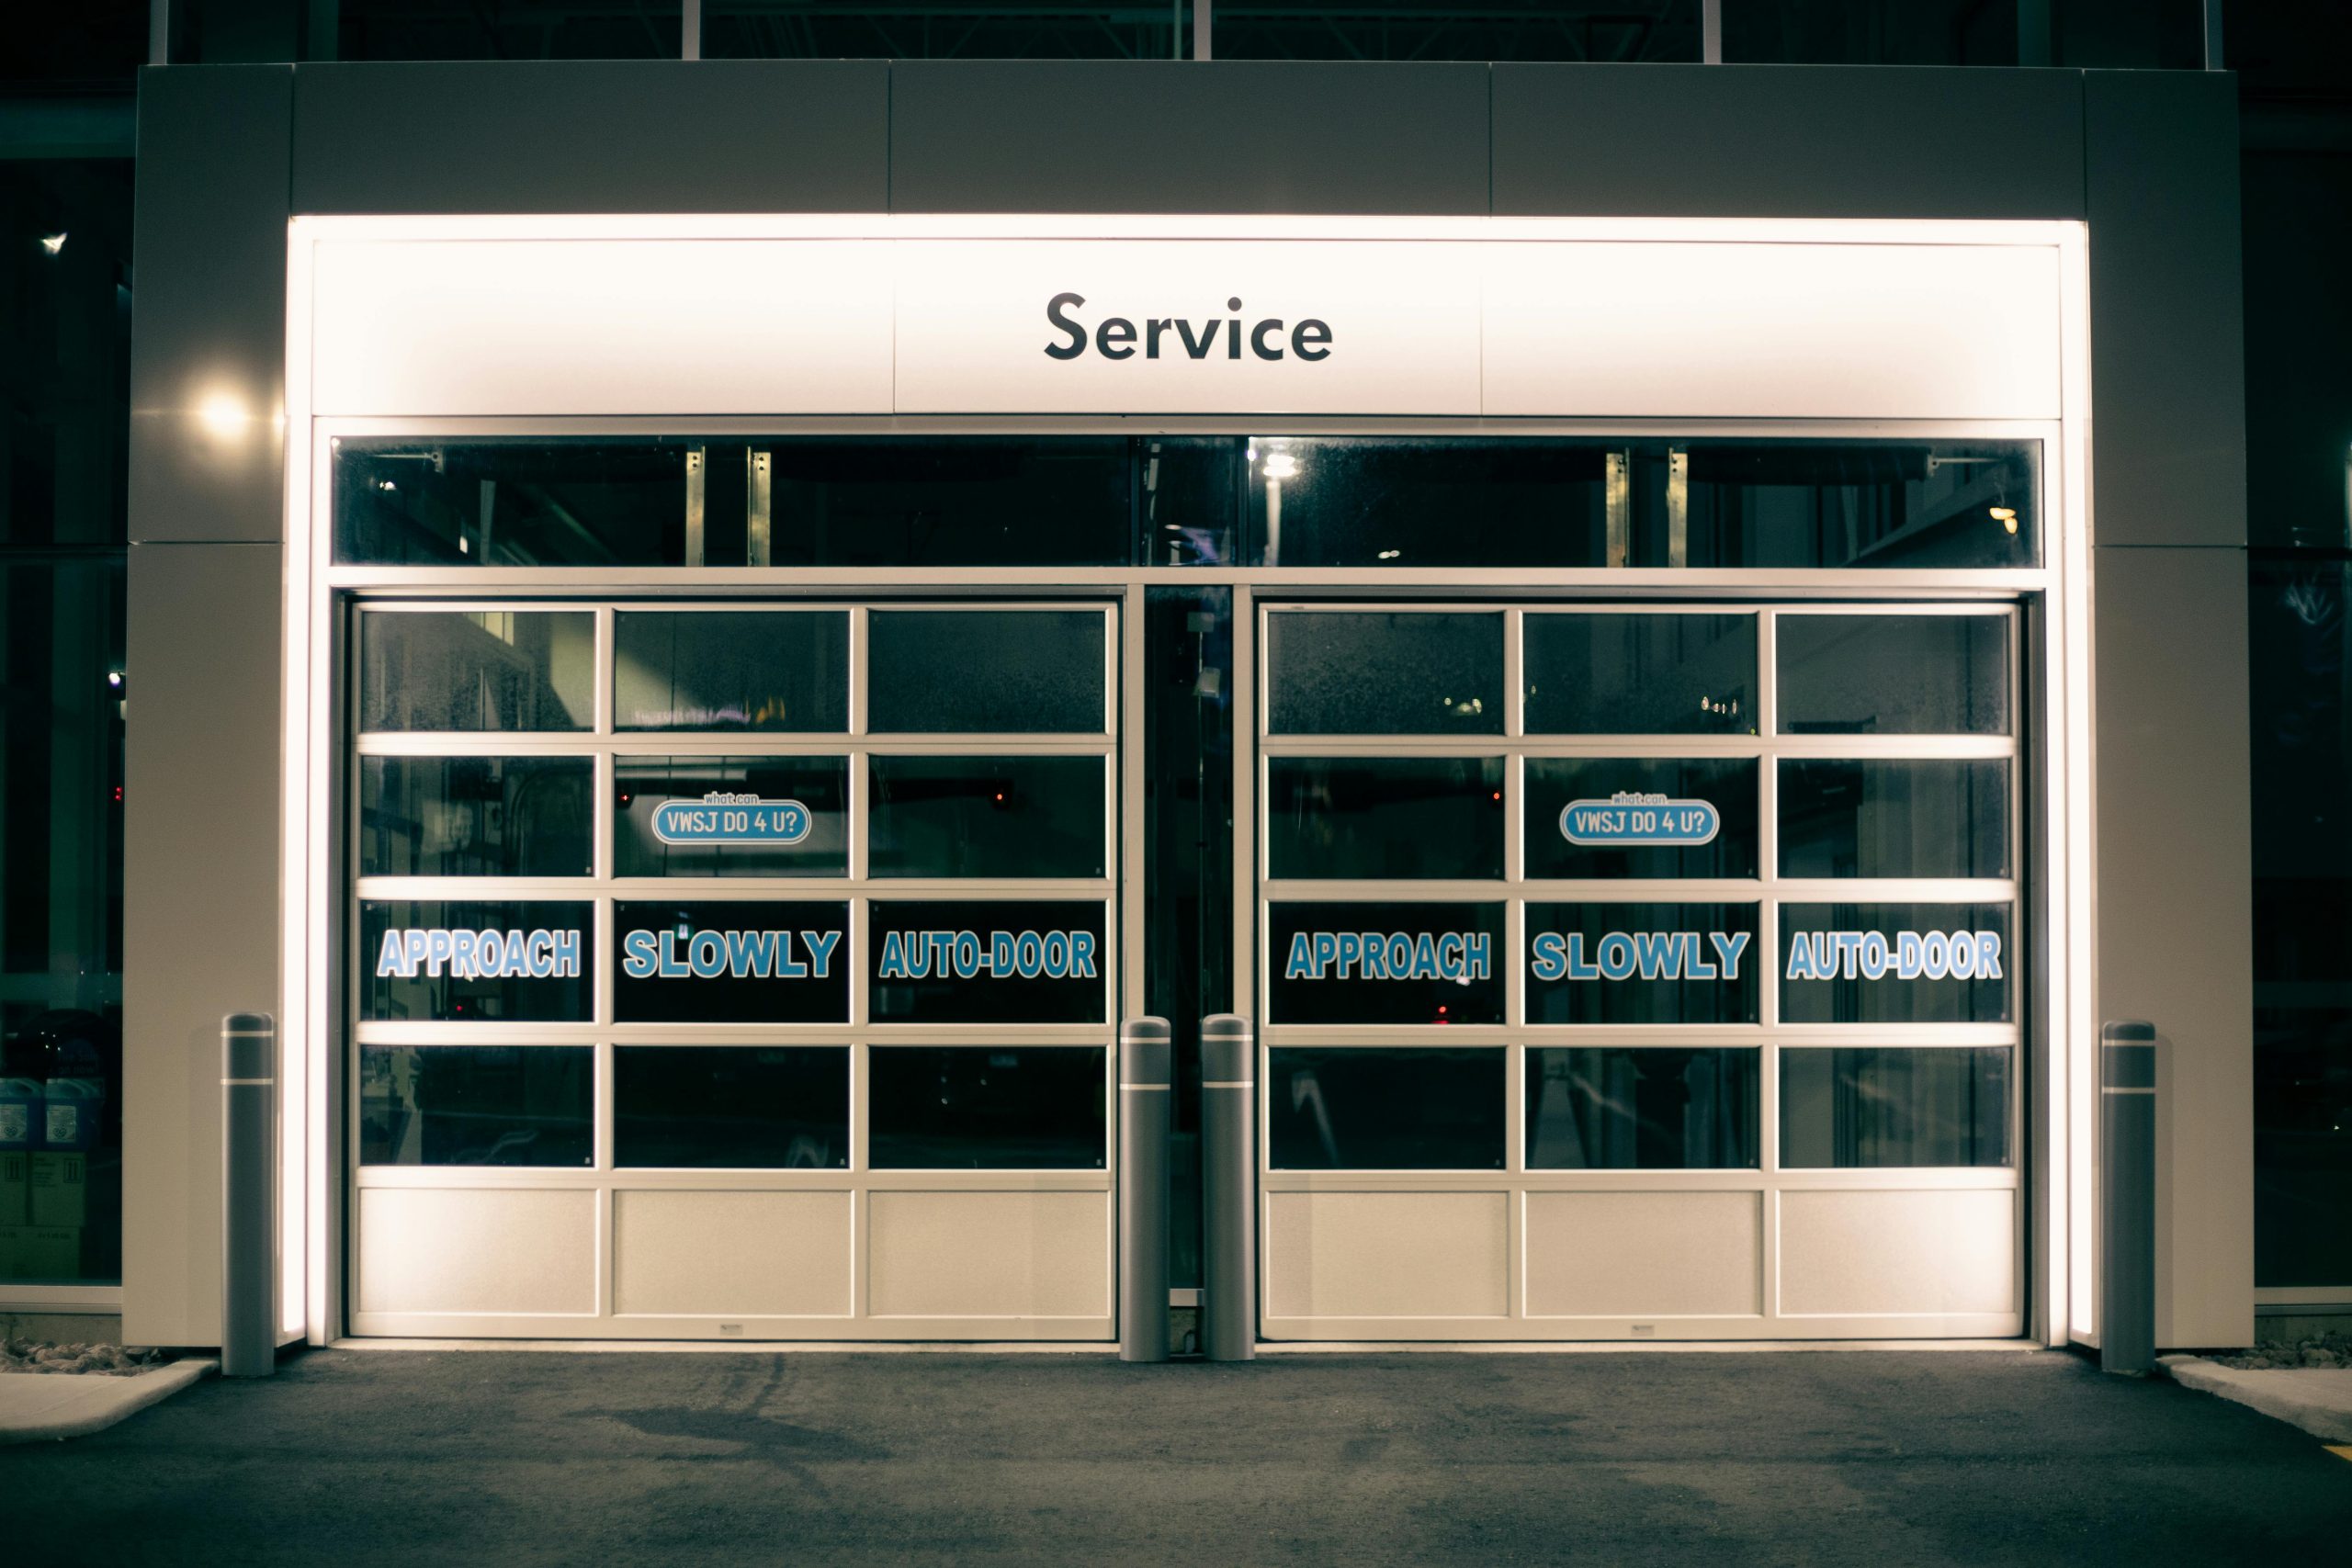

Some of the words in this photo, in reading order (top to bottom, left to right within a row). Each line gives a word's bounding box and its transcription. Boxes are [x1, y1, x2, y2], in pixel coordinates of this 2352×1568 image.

[1044, 292, 1332, 361] Service
[705, 791, 734, 805] what
[736, 794, 759, 805] can
[1612, 791, 1641, 805] what
[1644, 794, 1667, 805] can
[667, 811, 718, 833] VWSJ
[724, 811, 748, 833] DO
[753, 811, 767, 832] 4
[773, 811, 797, 833] U?
[1575, 811, 1626, 833] VWSJ
[1632, 811, 1656, 833] DO
[1662, 811, 1676, 832] 4
[1680, 811, 1706, 833] U?
[377, 929, 581, 978] APPROACH
[623, 929, 842, 978] SLOWLY
[878, 930, 1098, 979] AUTO-DOOR
[1285, 931, 1491, 981] APPROACH
[1532, 931, 1751, 980] SLOWLY
[1786, 930, 2004, 980] AUTO-DOOR
